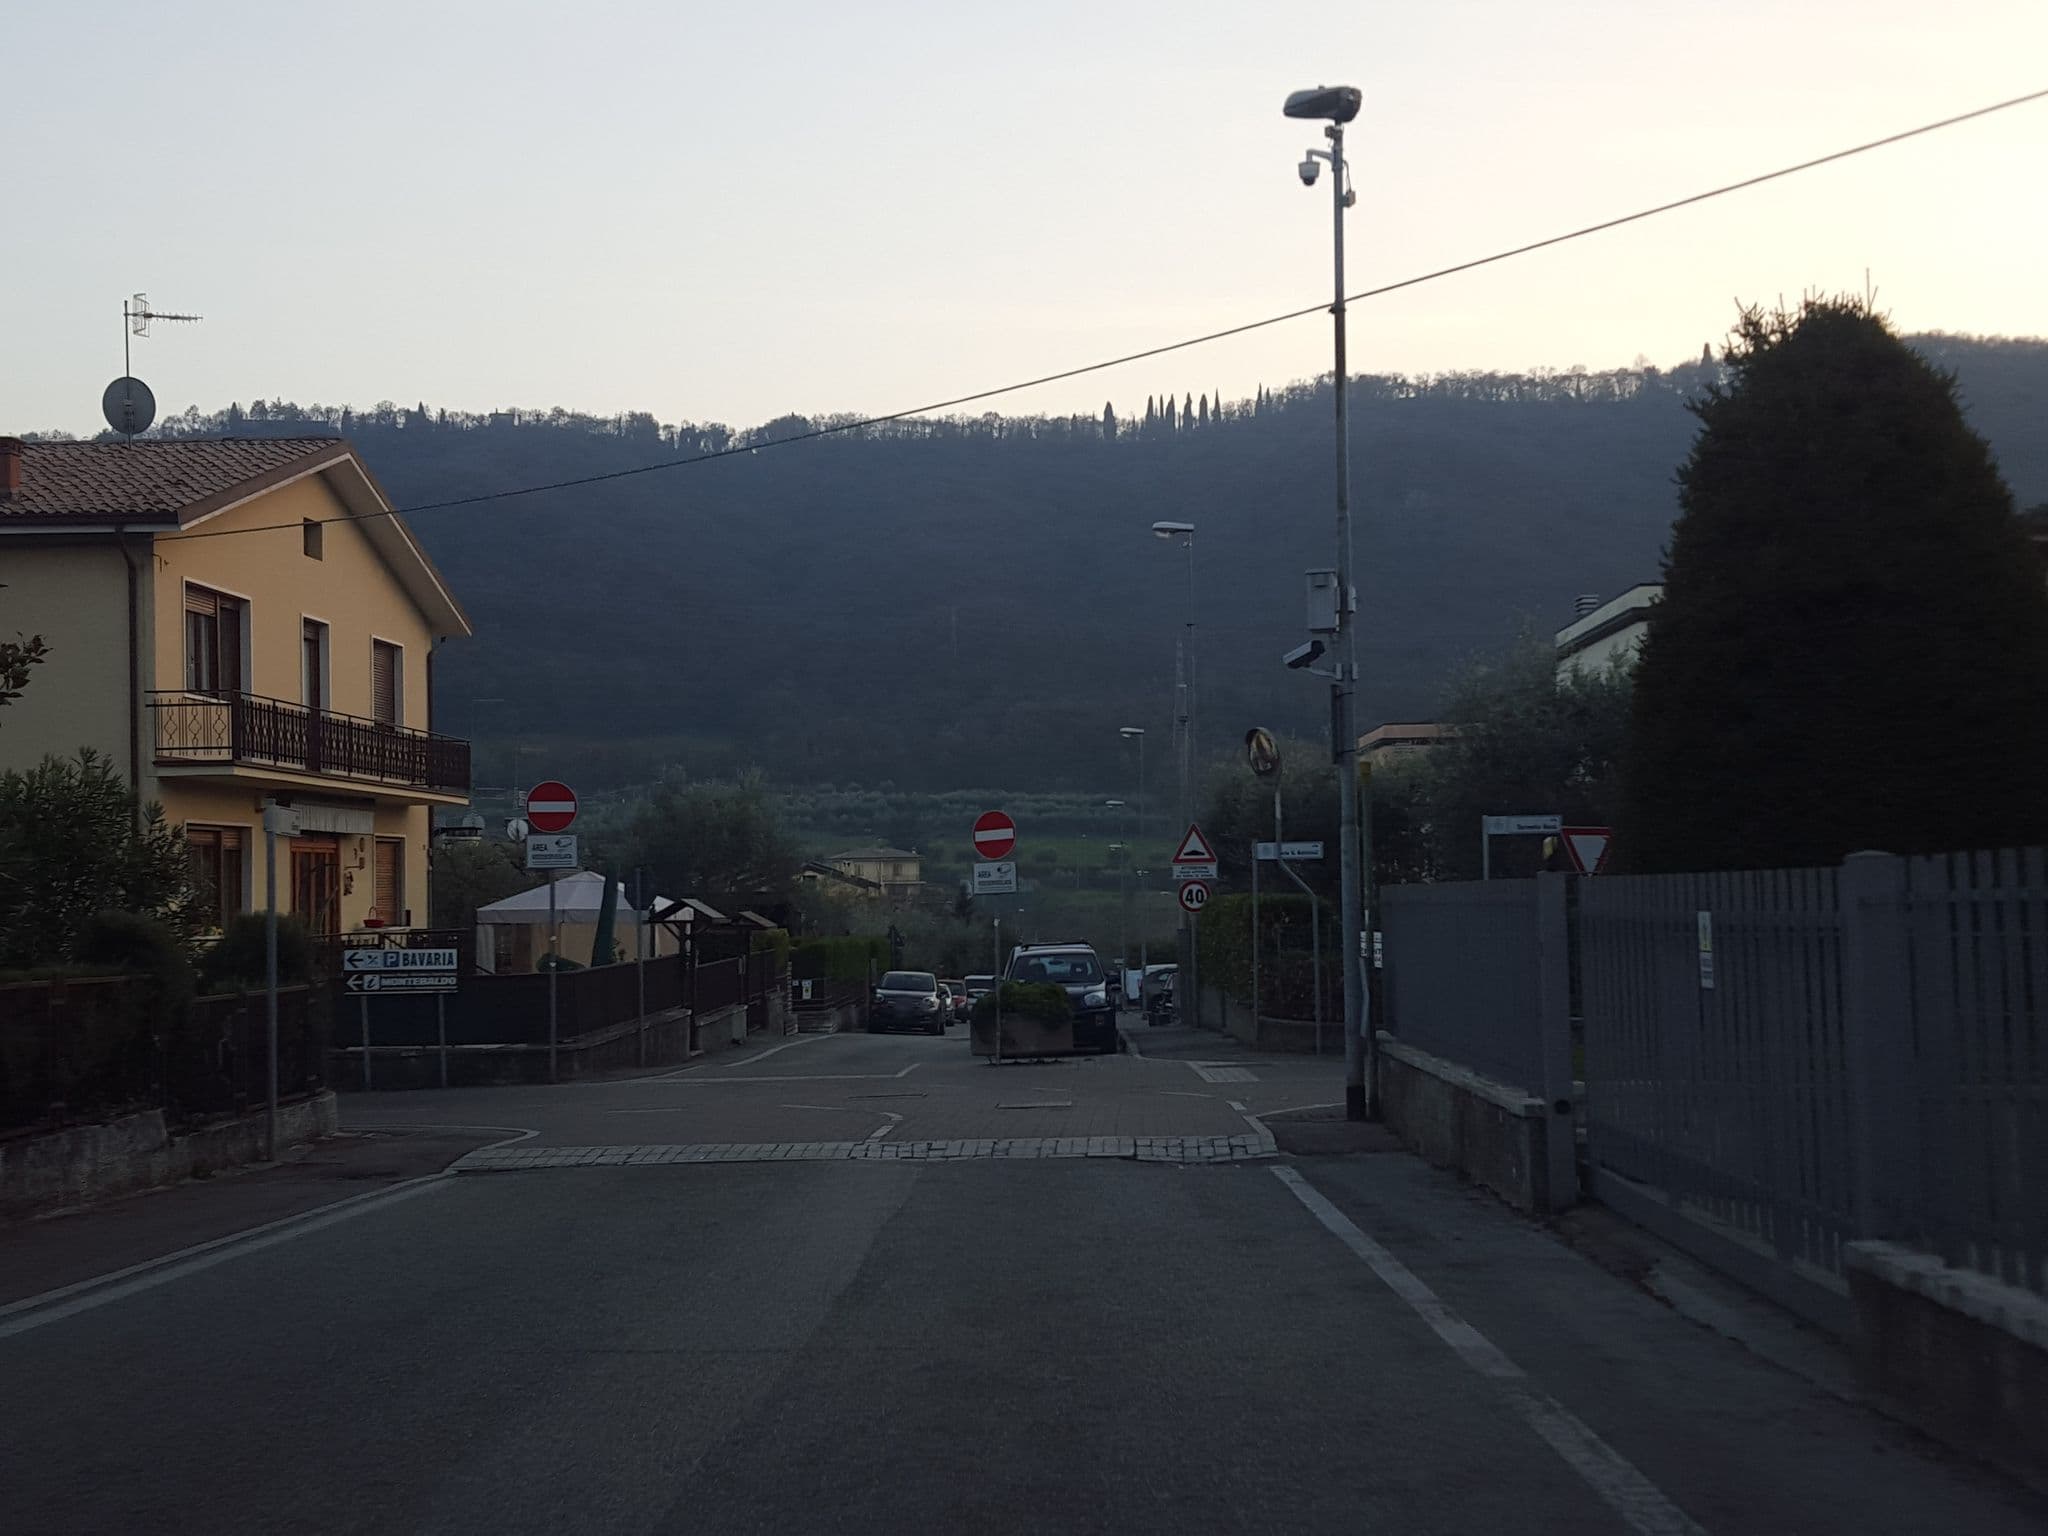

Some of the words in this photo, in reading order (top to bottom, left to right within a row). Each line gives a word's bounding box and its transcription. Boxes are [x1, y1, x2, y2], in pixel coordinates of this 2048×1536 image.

[1185, 888, 1205, 904] 40
[402, 952, 454, 967] BAVARIA
[381, 976, 457, 987] MONTEBALDO
